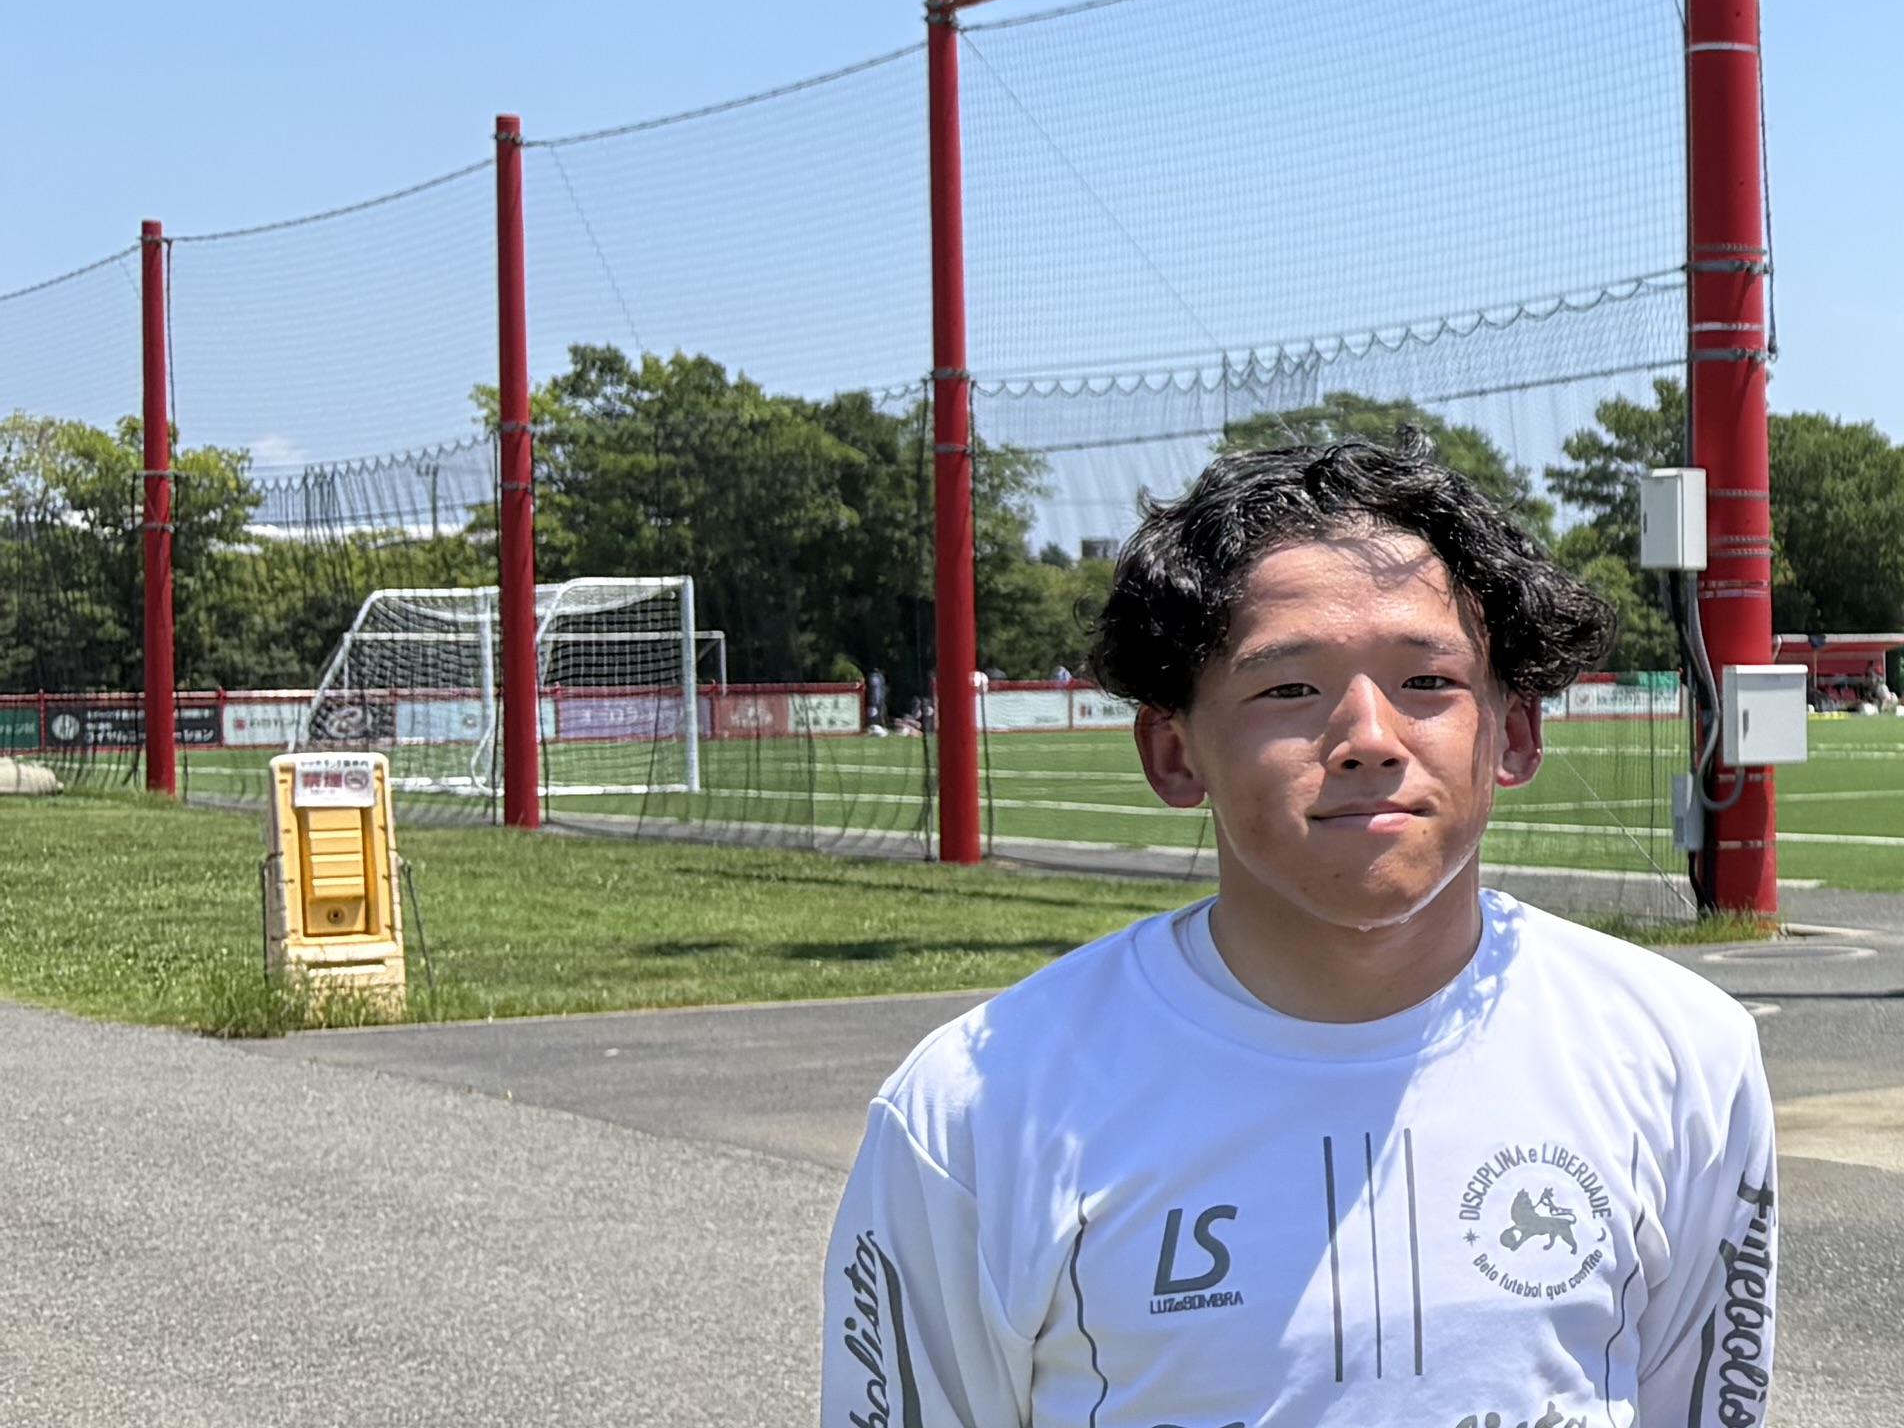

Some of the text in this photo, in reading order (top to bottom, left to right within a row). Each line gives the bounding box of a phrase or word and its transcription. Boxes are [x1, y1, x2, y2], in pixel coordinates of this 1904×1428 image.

[1459, 1143, 1612, 1221] DISCIPLINA e LIBERDADE
[1153, 1204, 1239, 1296] LS
[1472, 1253, 1498, 1281] Belo
[1546, 1281, 1567, 1301] que
